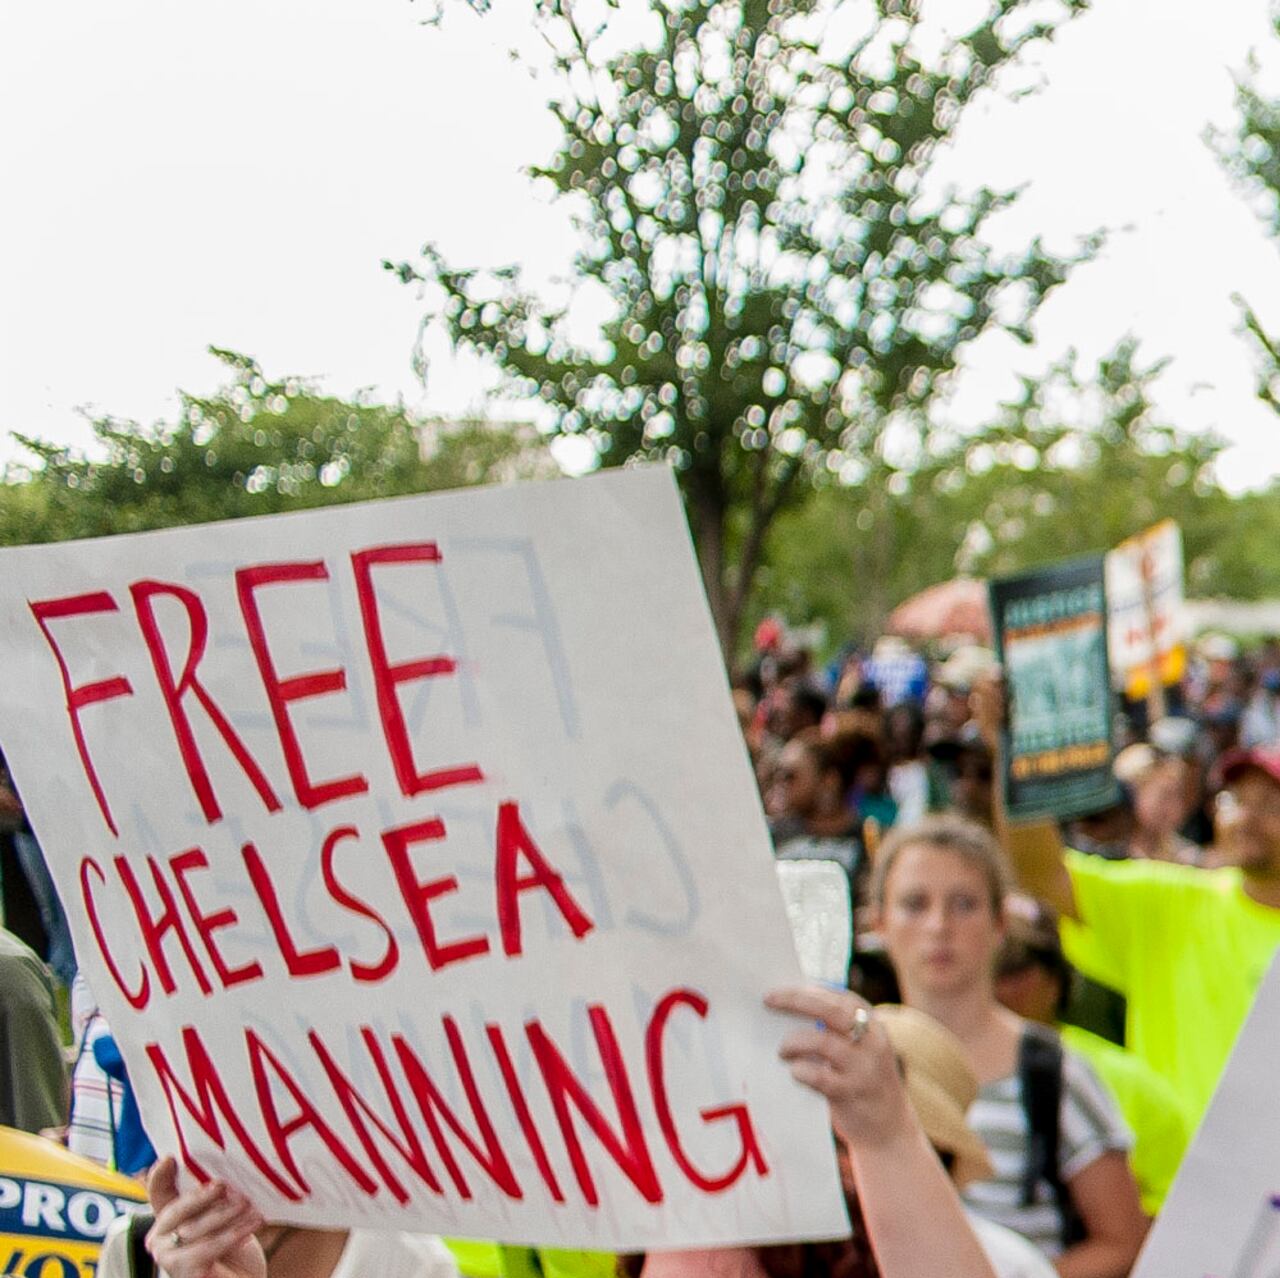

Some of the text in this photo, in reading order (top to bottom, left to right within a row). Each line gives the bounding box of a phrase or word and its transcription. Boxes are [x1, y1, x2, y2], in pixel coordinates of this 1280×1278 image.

[27, 541, 487, 838] FREE
[79, 801, 596, 1012] CHELSEA
[145, 987, 771, 1209] MANNING
